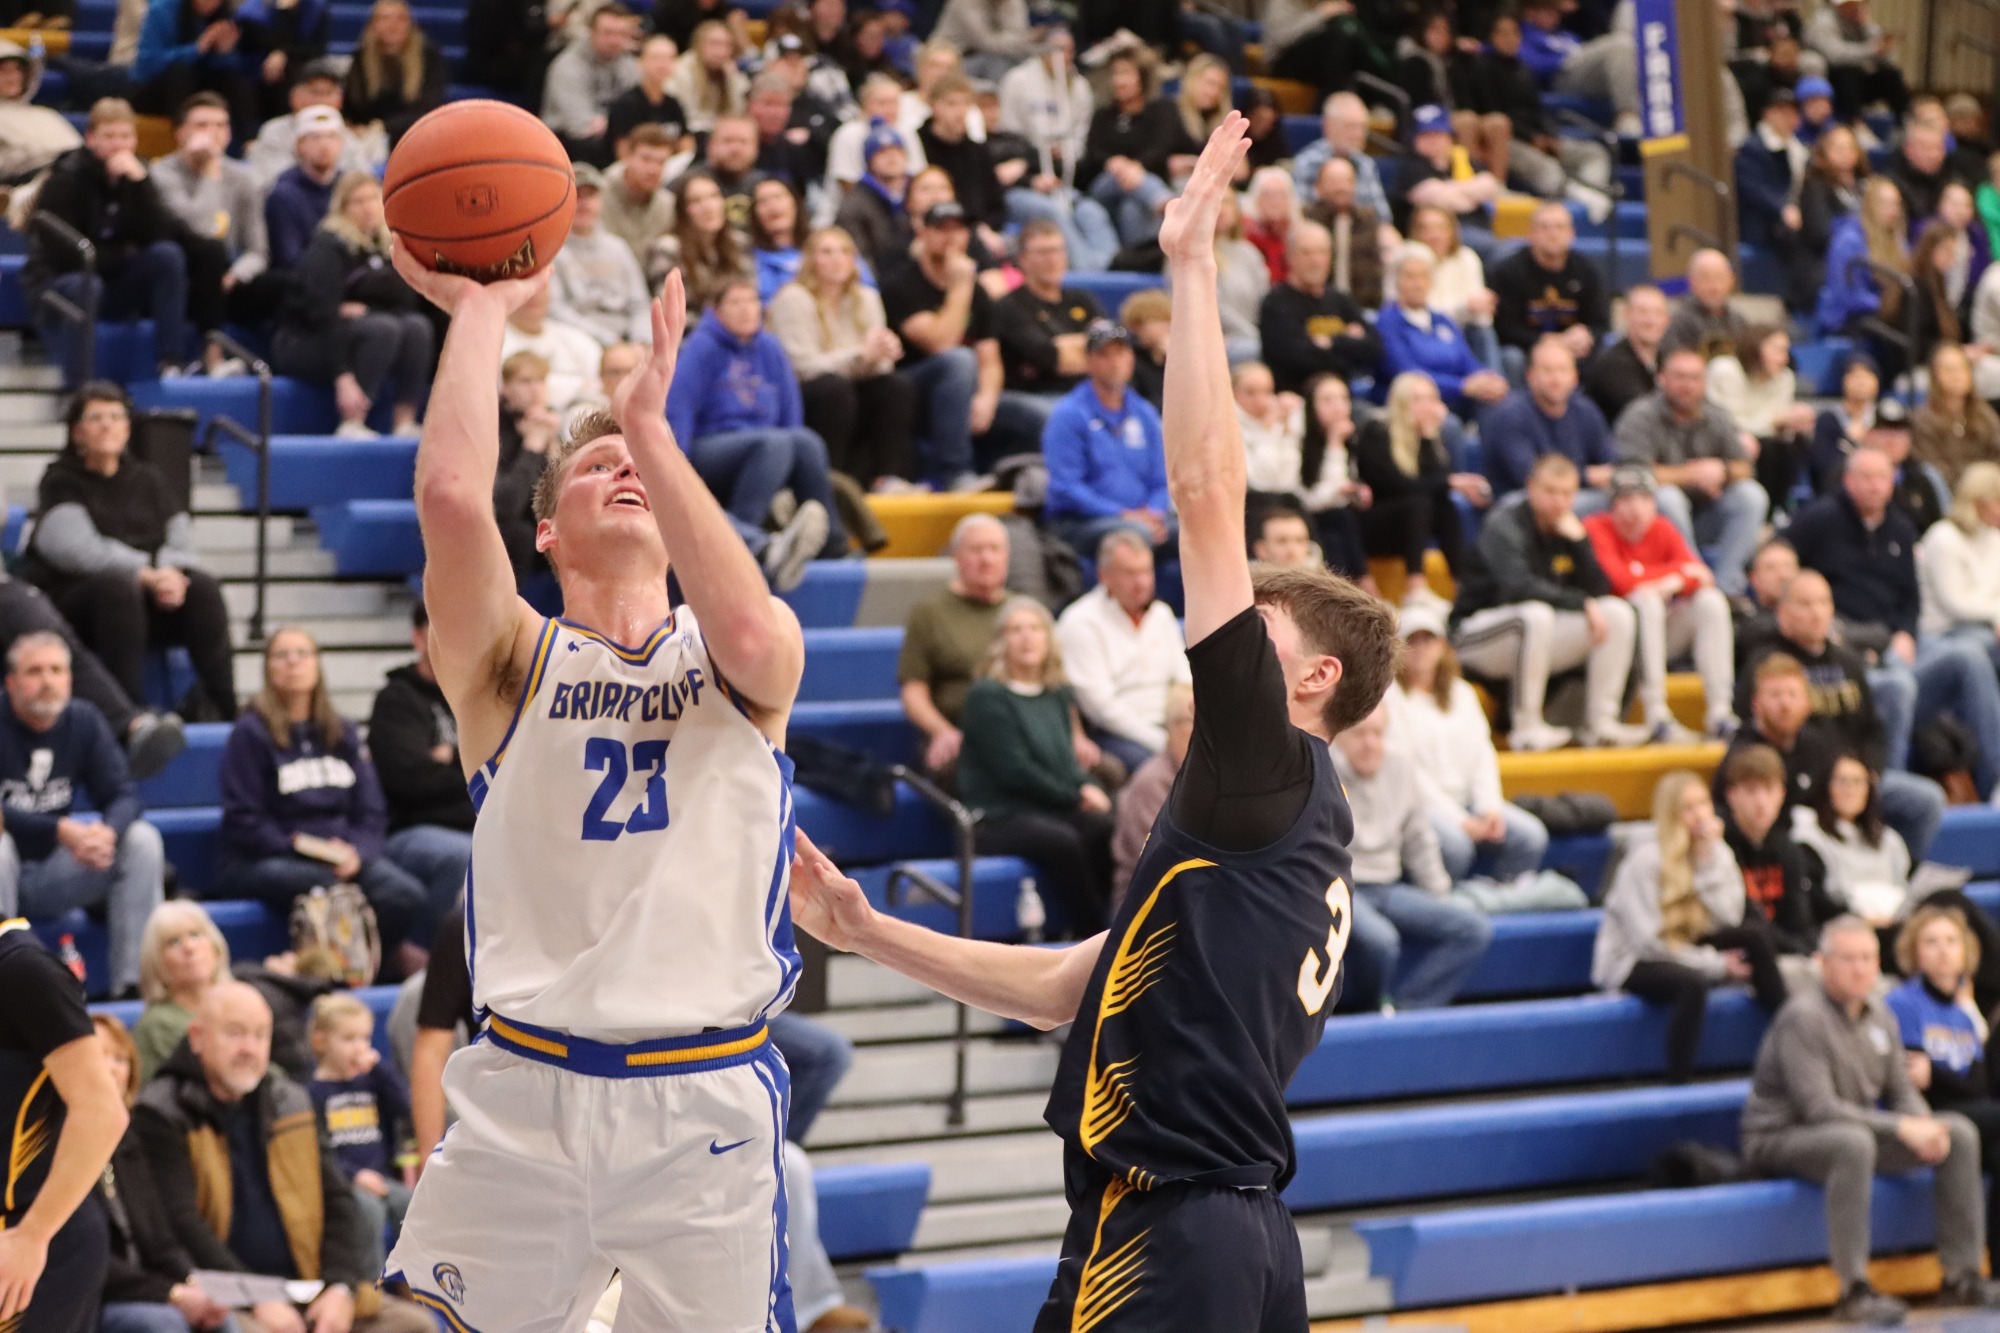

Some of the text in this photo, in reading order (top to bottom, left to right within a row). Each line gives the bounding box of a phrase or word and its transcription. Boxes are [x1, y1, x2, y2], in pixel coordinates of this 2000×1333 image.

[548, 680, 644, 722] BRIAR
[581, 736, 670, 842] 23
[1297, 876, 1351, 1016] 3
